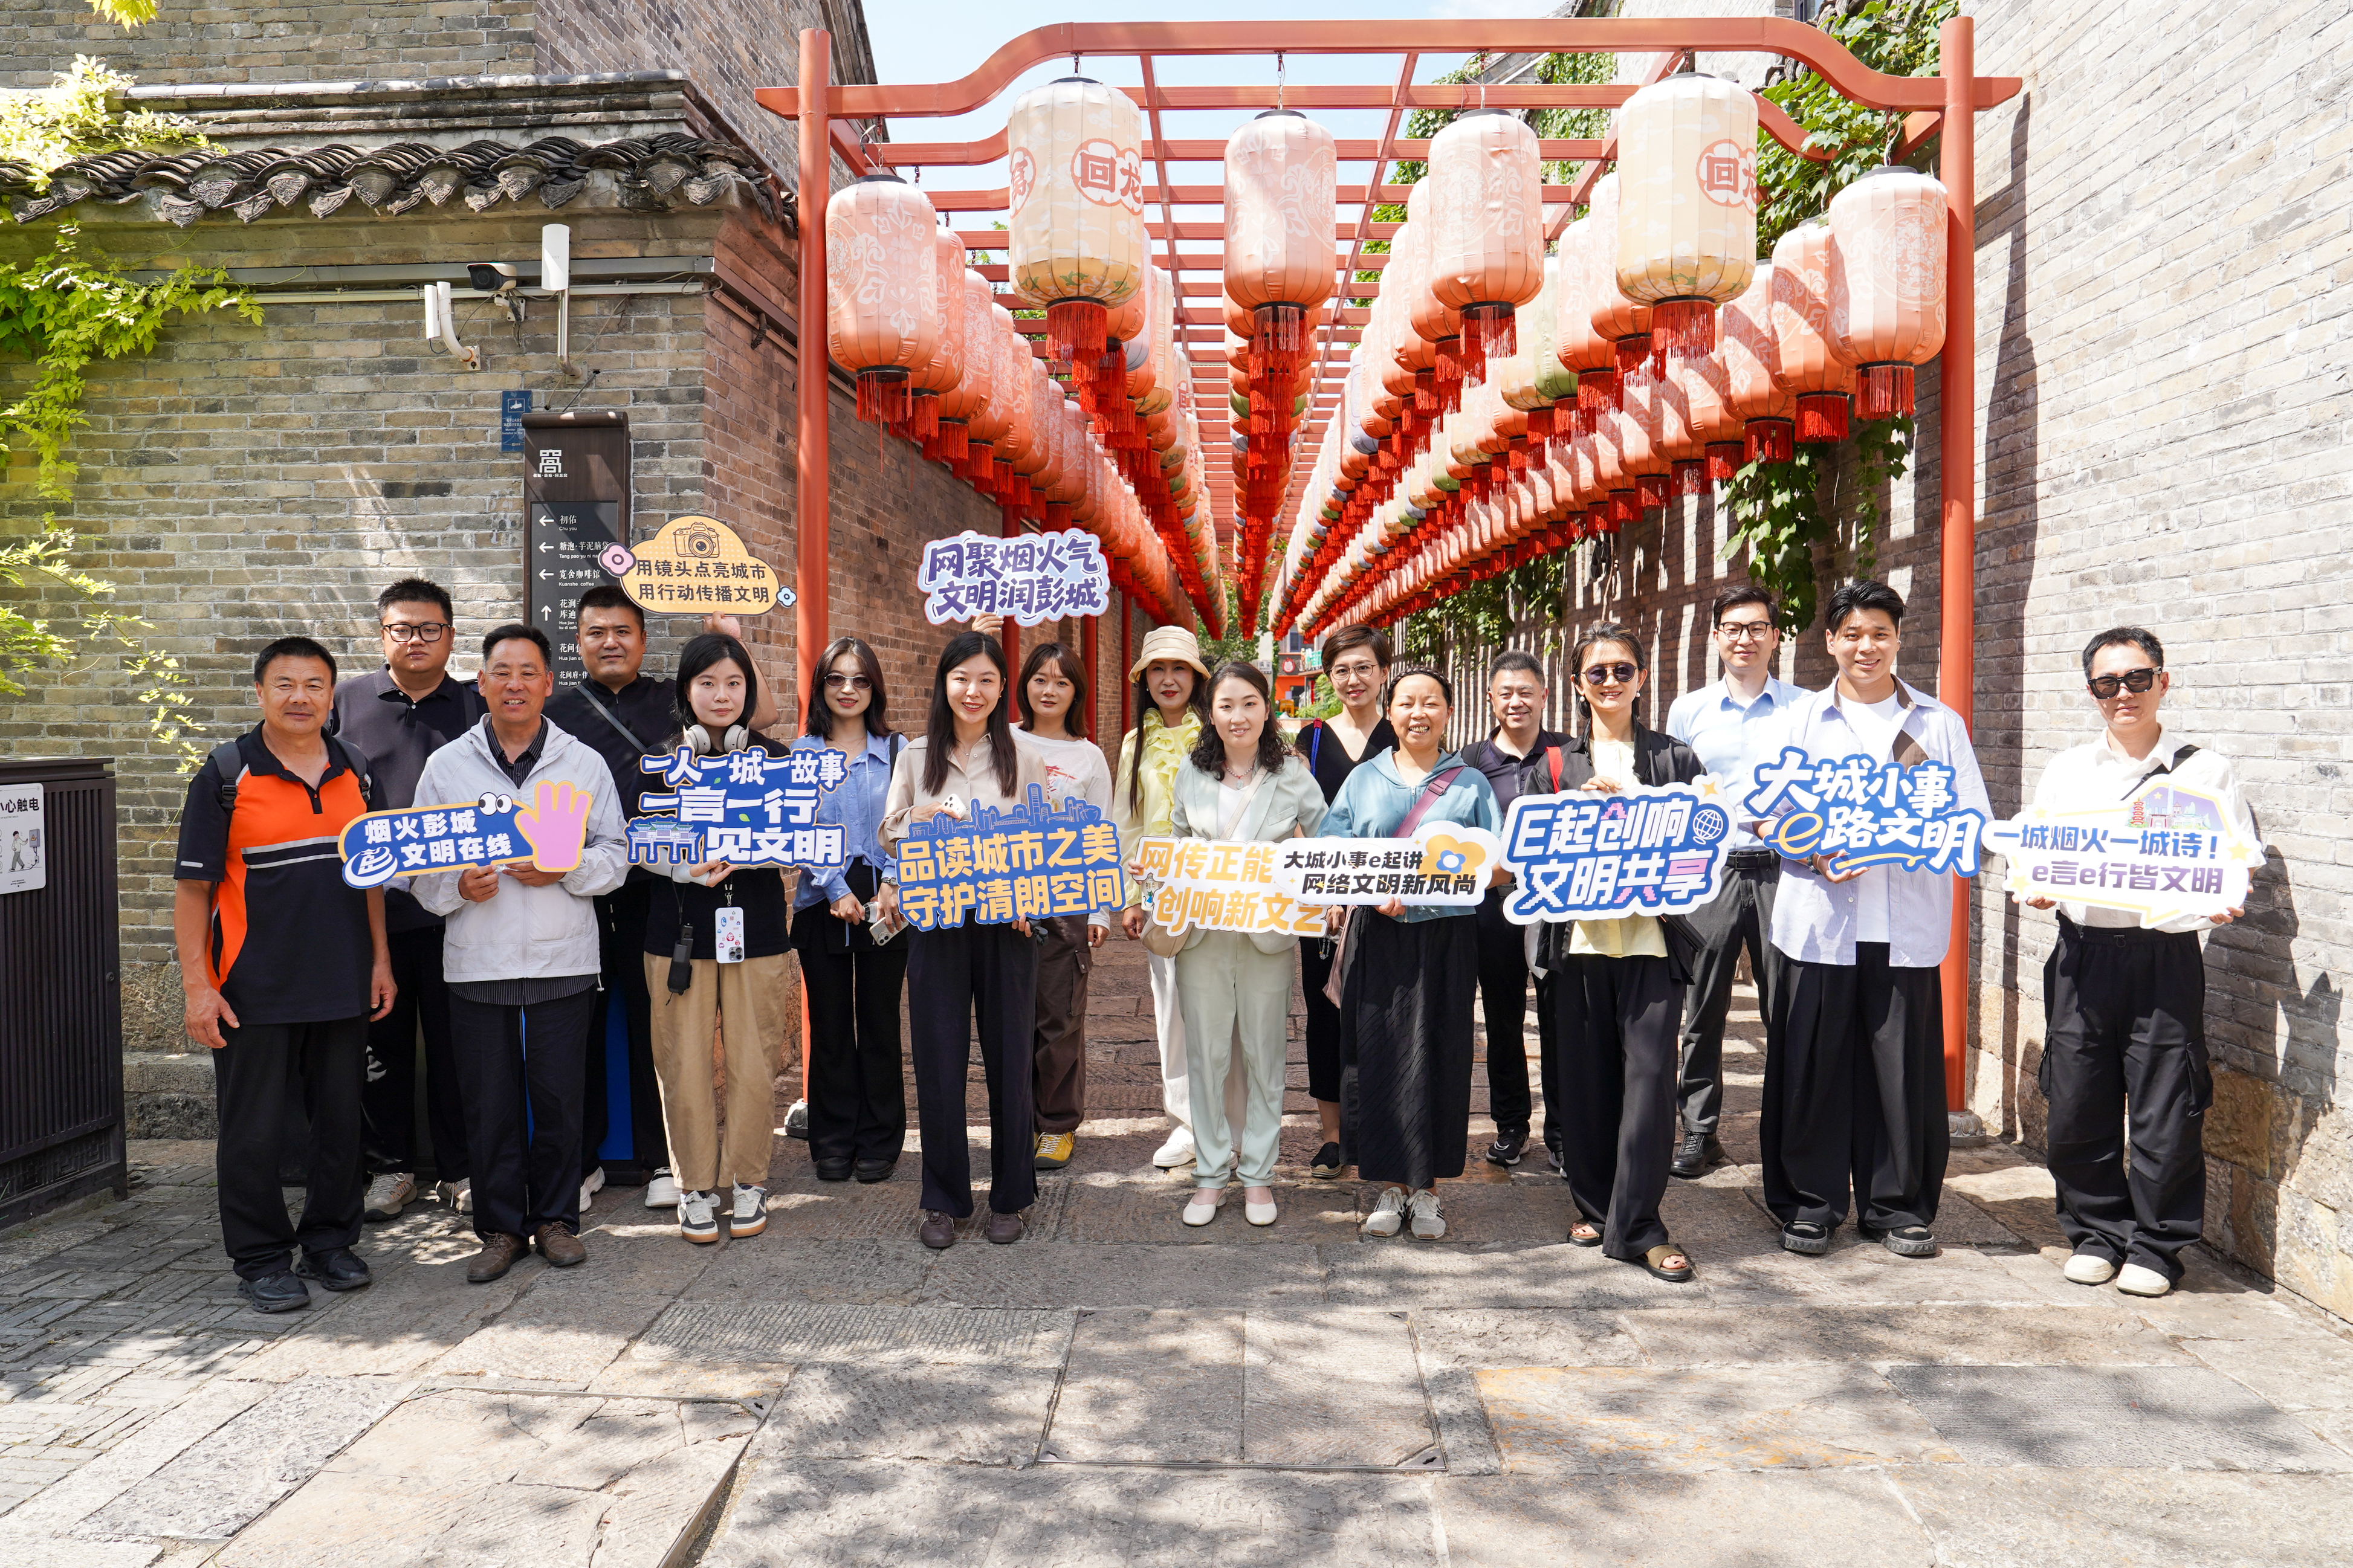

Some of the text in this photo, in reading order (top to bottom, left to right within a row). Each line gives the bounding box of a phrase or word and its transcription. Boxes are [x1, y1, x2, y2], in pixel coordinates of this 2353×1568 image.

[559, 515, 577, 524] 初佑
[559, 569, 601, 579] 宽舍咖啡馆
[636, 560, 766, 580] 用镜头点亮城市
[928, 537, 1099, 582] 网聚烟火气
[559, 598, 581, 608] 花涧
[638, 583, 769, 603] 用行动传播文明
[936, 575, 1102, 617] 文明润彭城
[644, 749, 845, 789] 一人一城一故事
[1748, 751, 1953, 819] 大城小事
[643, 786, 818, 824] 一言一行
[364, 809, 477, 845] 烟火彭城
[706, 826, 843, 864] 见文明
[1512, 798, 1694, 857] E起创响
[1769, 806, 1981, 873] e路文明
[401, 832, 513, 868] 文明在线
[899, 823, 1118, 883] 品读城市之美
[1138, 841, 1277, 883] 网传正能
[1284, 851, 1423, 869] 大城小事e起讲
[1302, 873, 1477, 895] 网络文明新风尚
[1519, 848, 1714, 910] 文明共享
[2031, 860, 2224, 894] e言e行皆文明
[902, 868, 1123, 928] 守护清朗空间
